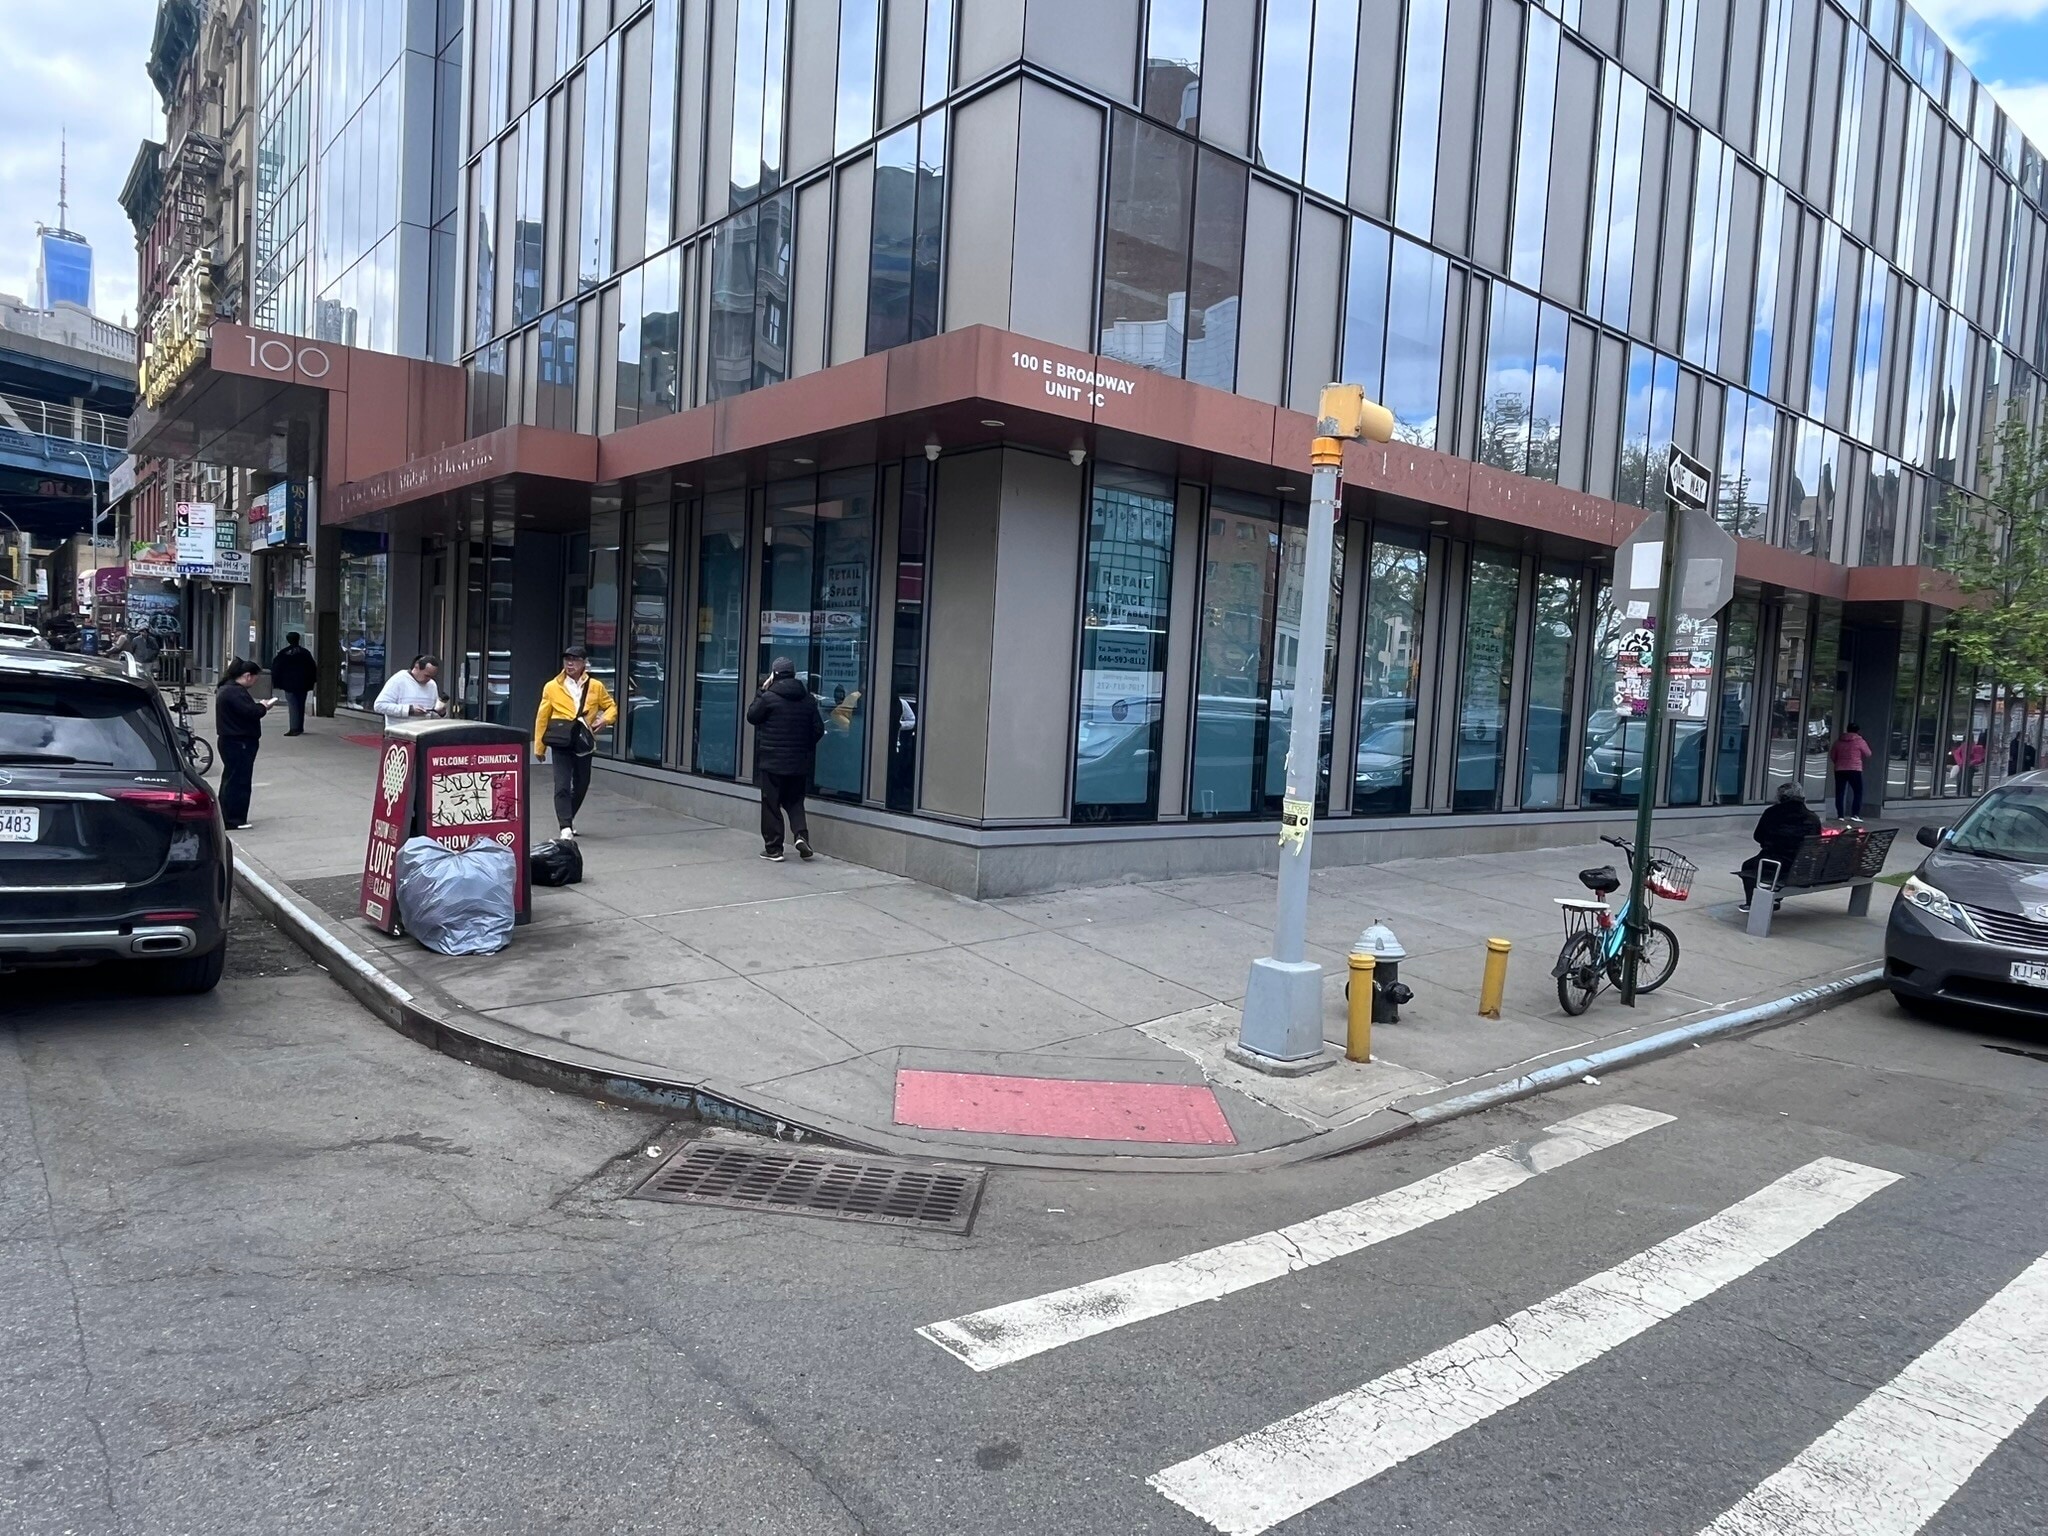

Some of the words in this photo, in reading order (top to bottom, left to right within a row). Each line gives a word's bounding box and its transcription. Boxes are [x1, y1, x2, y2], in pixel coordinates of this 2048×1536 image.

[245, 335, 330, 378] 100
[1011, 351, 1039, 371] 100
[1042, 359, 1053, 374] E
[1056, 362, 1136, 395] BROADWAY
[1045, 380, 1082, 401] UNIT
[1087, 391, 1105, 408] 1C
[1673, 463, 1686, 488] ONE
[1690, 474, 1706, 500] WAY
[1102, 571, 1151, 590] RETAIL
[432, 756, 469, 766] WELCOME
[368, 838, 396, 879] LOVE
